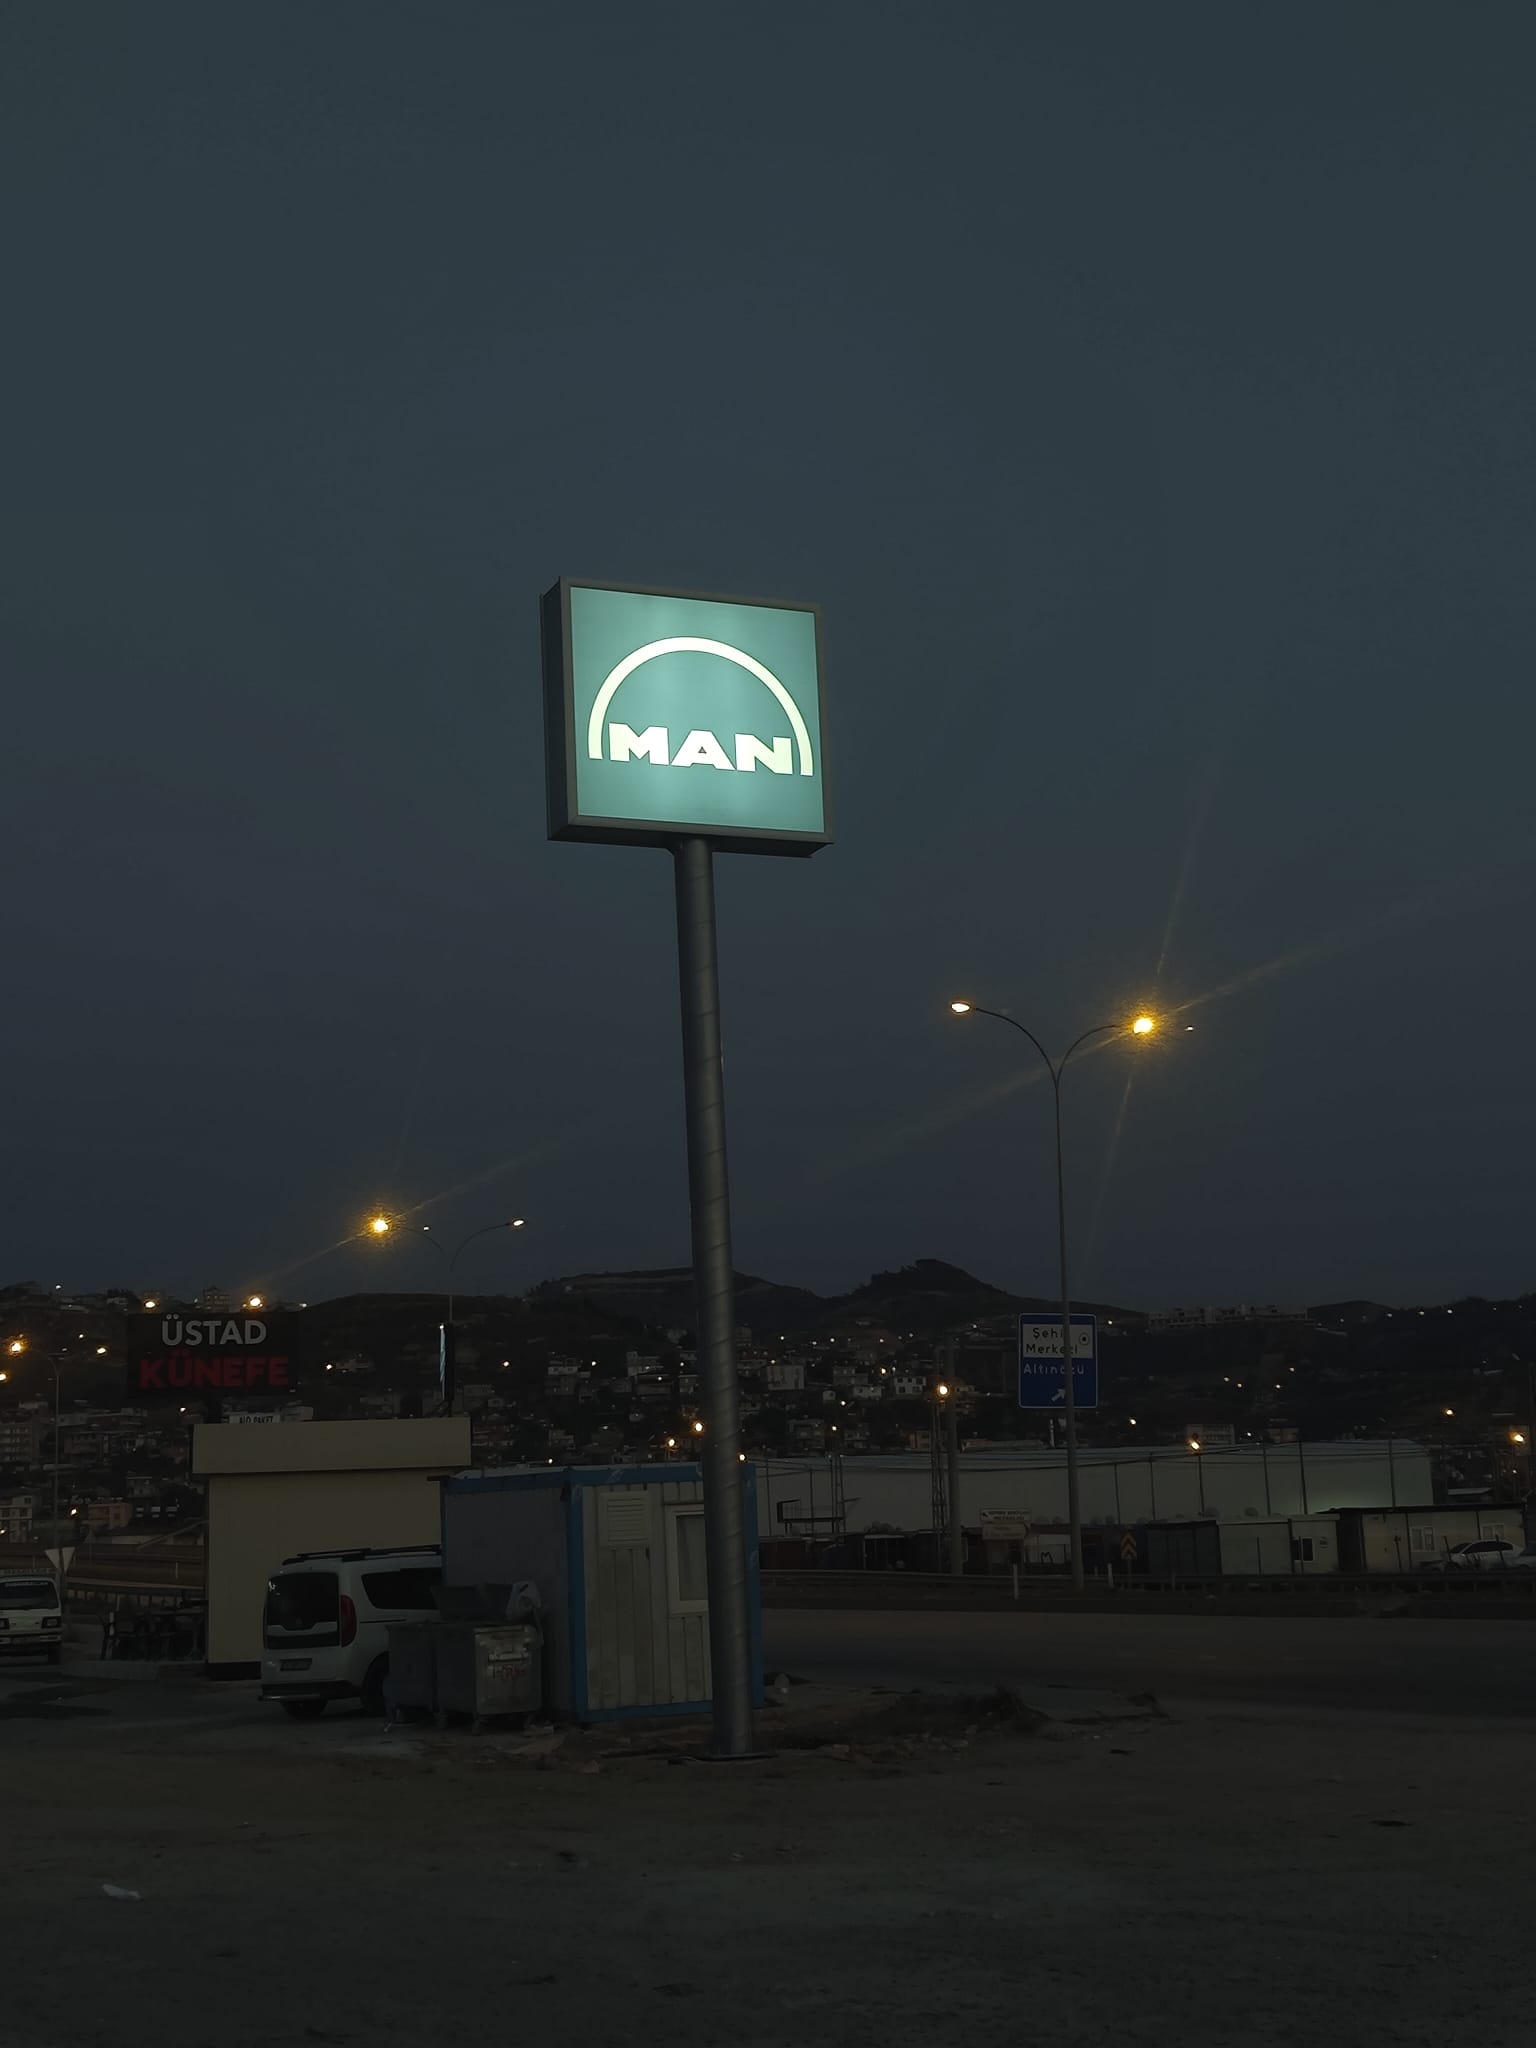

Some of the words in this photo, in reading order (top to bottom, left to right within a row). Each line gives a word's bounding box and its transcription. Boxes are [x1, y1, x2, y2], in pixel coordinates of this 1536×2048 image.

[608, 722, 793, 775] MAN
[161, 1314, 267, 1346] ÜSTAD
[1032, 1327, 1065, 1339] Şehi
[140, 1348, 289, 1389] KÜNEFE
